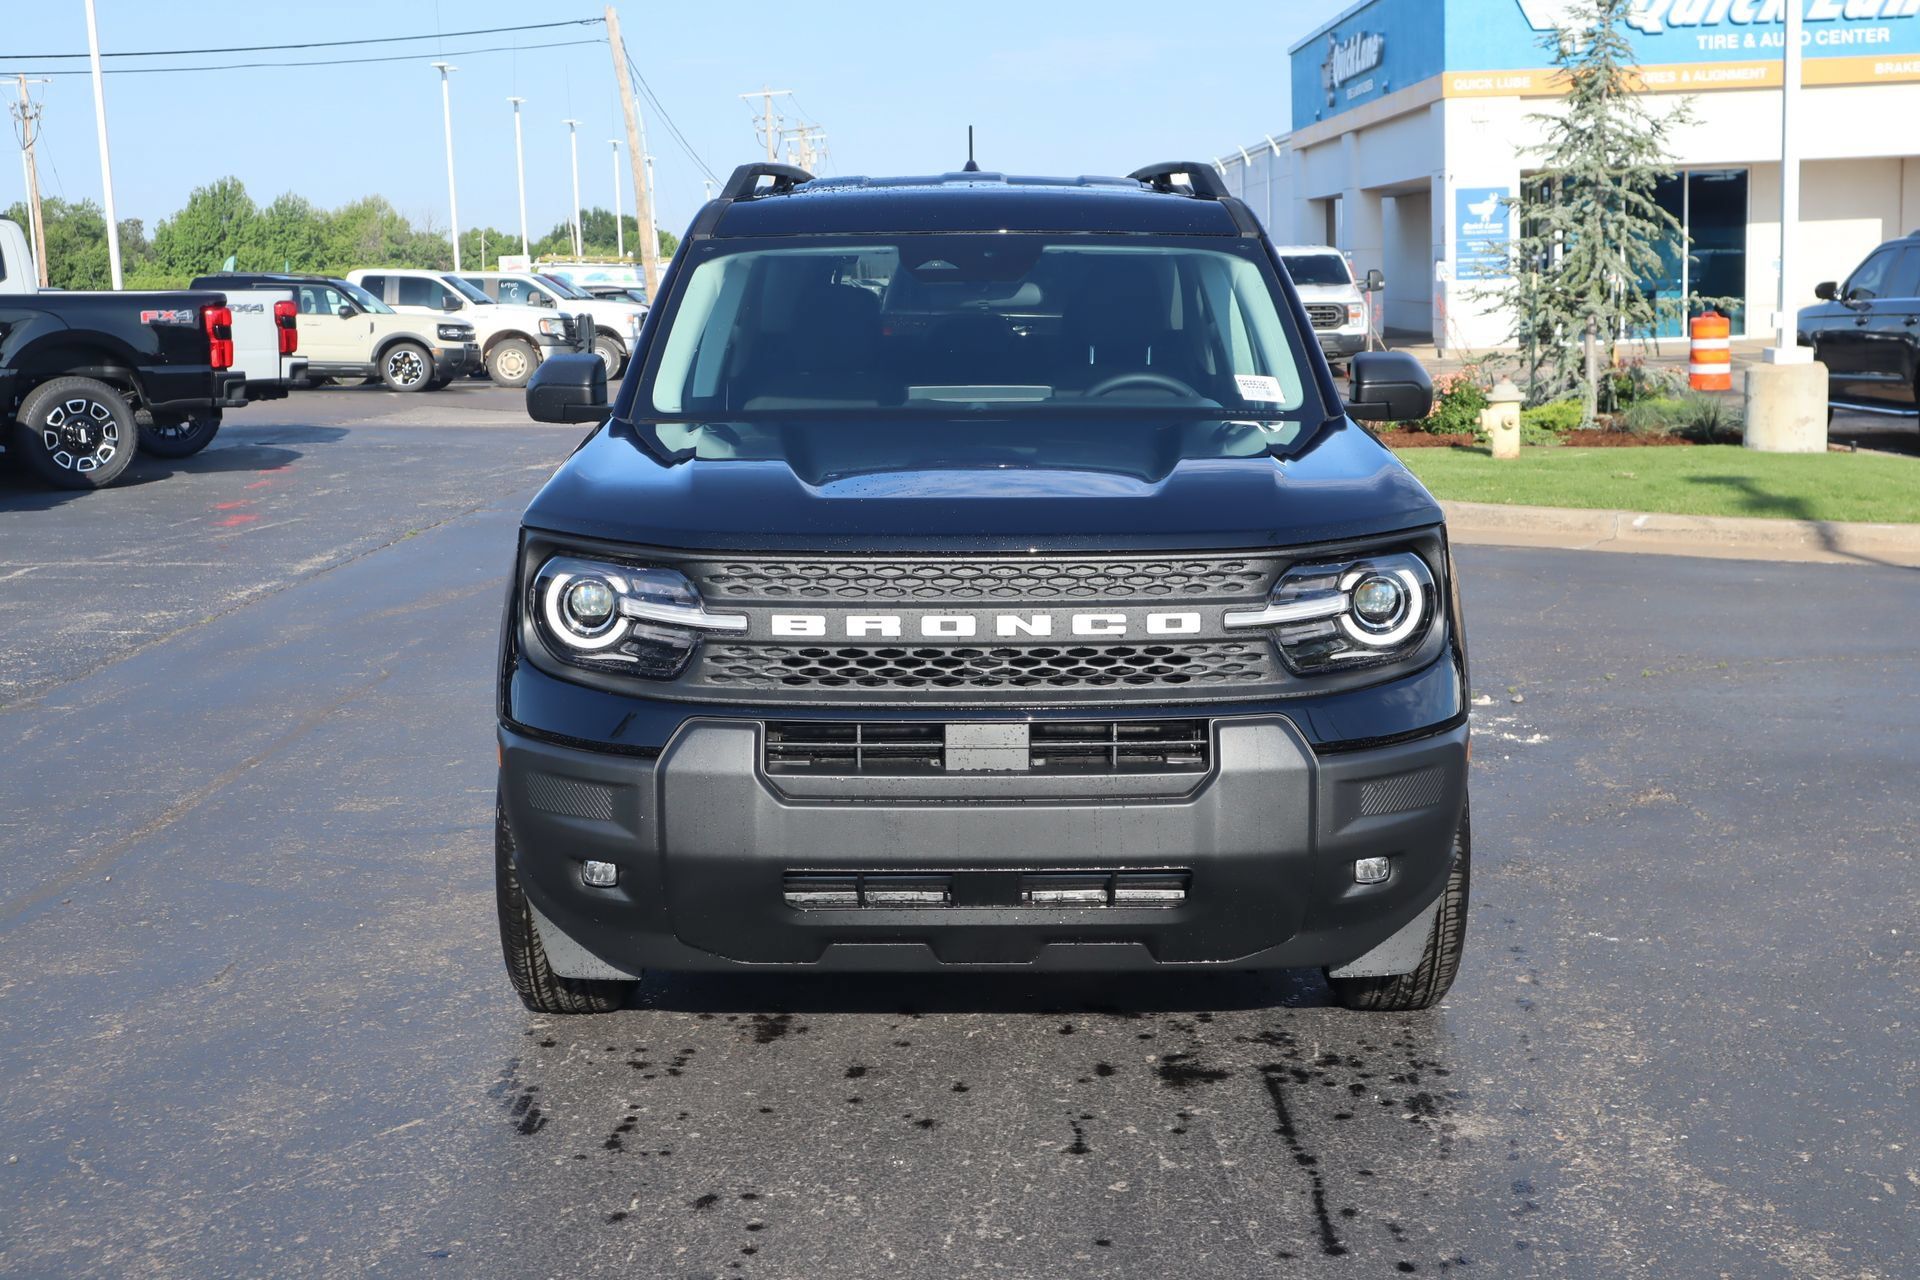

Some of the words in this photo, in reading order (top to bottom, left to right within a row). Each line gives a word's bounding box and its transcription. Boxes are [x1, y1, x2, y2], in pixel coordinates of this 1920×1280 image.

[1697, 35, 1739, 50] TIRE
[1743, 34, 1757, 49] &
[1760, 32, 1811, 48] AUO
[1815, 27, 1890, 46] CENTER
[1681, 70, 1691, 83] &
[1692, 67, 1768, 82] ALIGNMENT
[1454, 78, 1493, 91] QUICK
[1496, 76, 1531, 89] LUBE
[140, 310, 194, 324] FX4
[771, 612, 1201, 637] BRONCO
